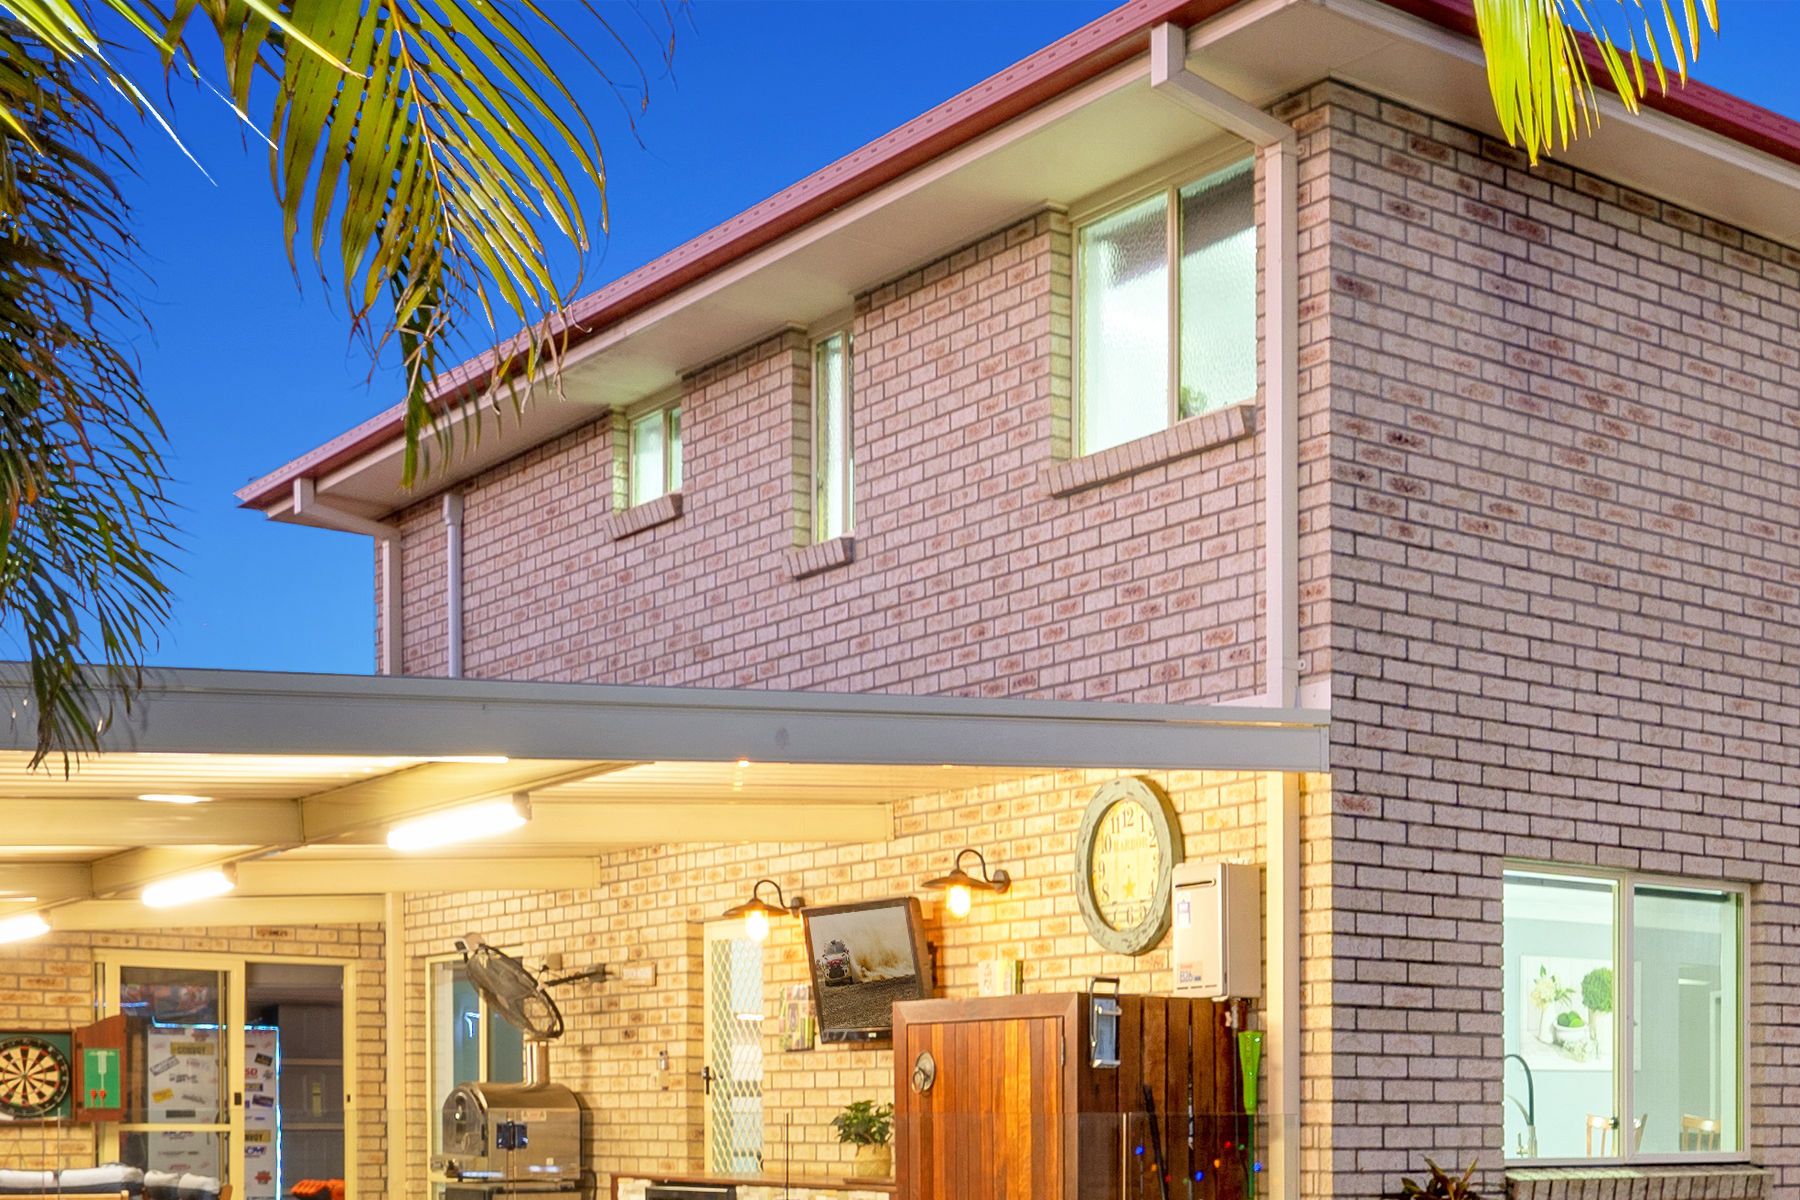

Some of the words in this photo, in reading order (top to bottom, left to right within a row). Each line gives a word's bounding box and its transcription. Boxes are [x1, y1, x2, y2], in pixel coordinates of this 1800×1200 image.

[1111, 815, 1120, 834] 11
[1123, 807, 1134, 828] 12
[1141, 814, 1145, 833] 1
[1101, 834, 1112, 854] 10
[1149, 829, 1157, 848] 2
[1098, 860, 1106, 880] 9
[1101, 882, 1110, 903] 8
[1126, 905, 1134, 925] 6
